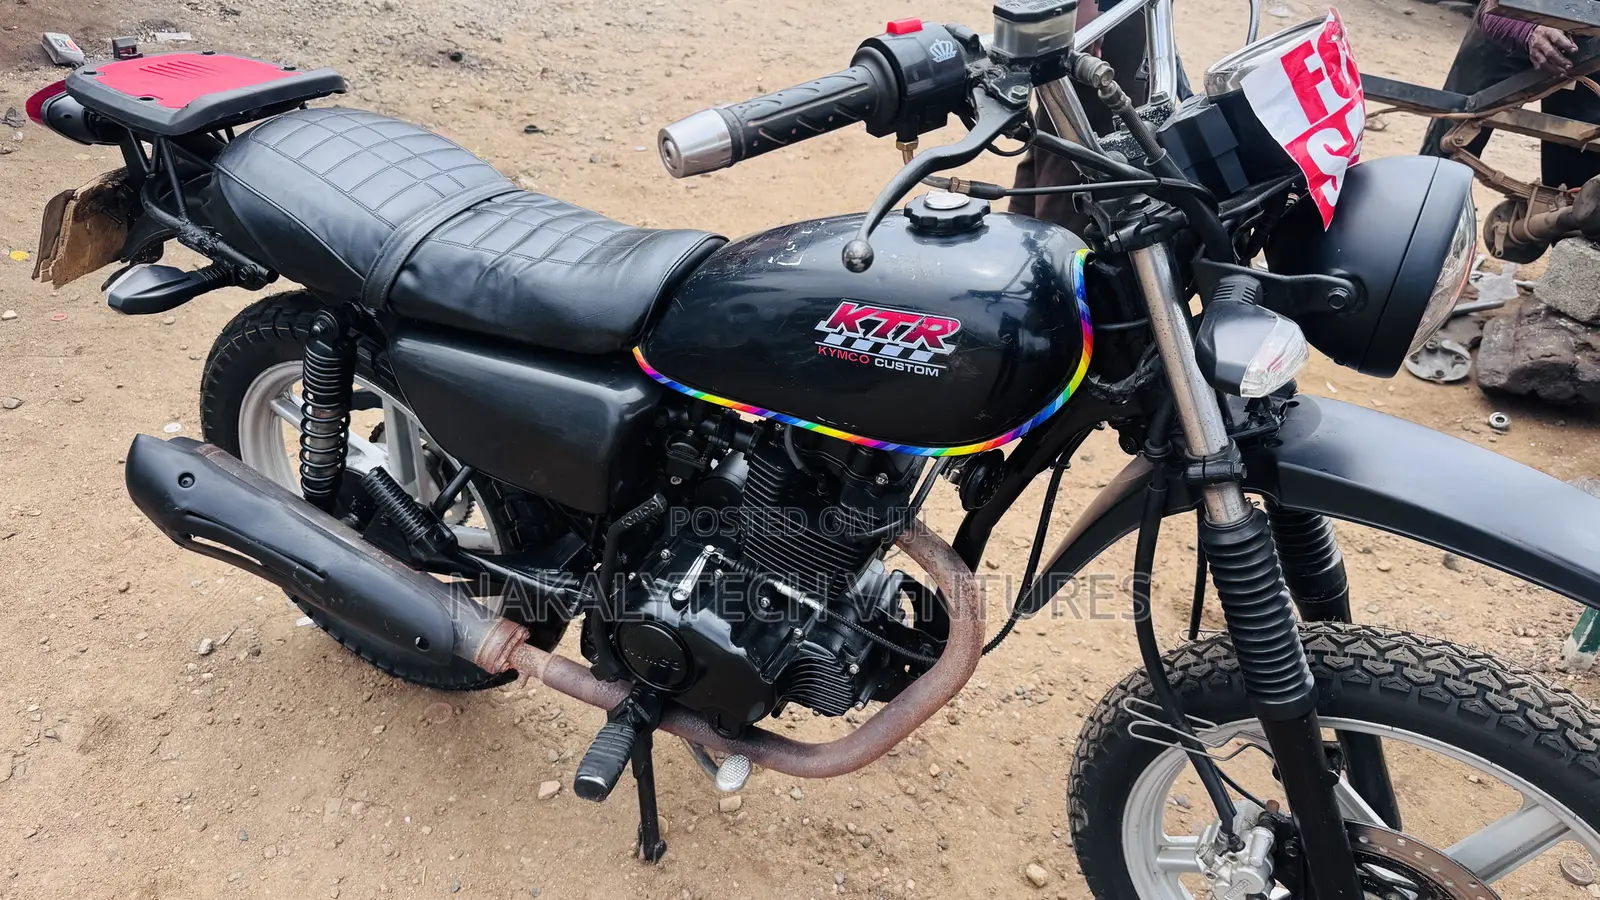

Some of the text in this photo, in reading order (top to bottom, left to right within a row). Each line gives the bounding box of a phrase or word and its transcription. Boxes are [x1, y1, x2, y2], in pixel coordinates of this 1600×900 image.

[819, 301, 961, 355] KTR
[817, 346, 939, 377] KYMCO CUSTOM
